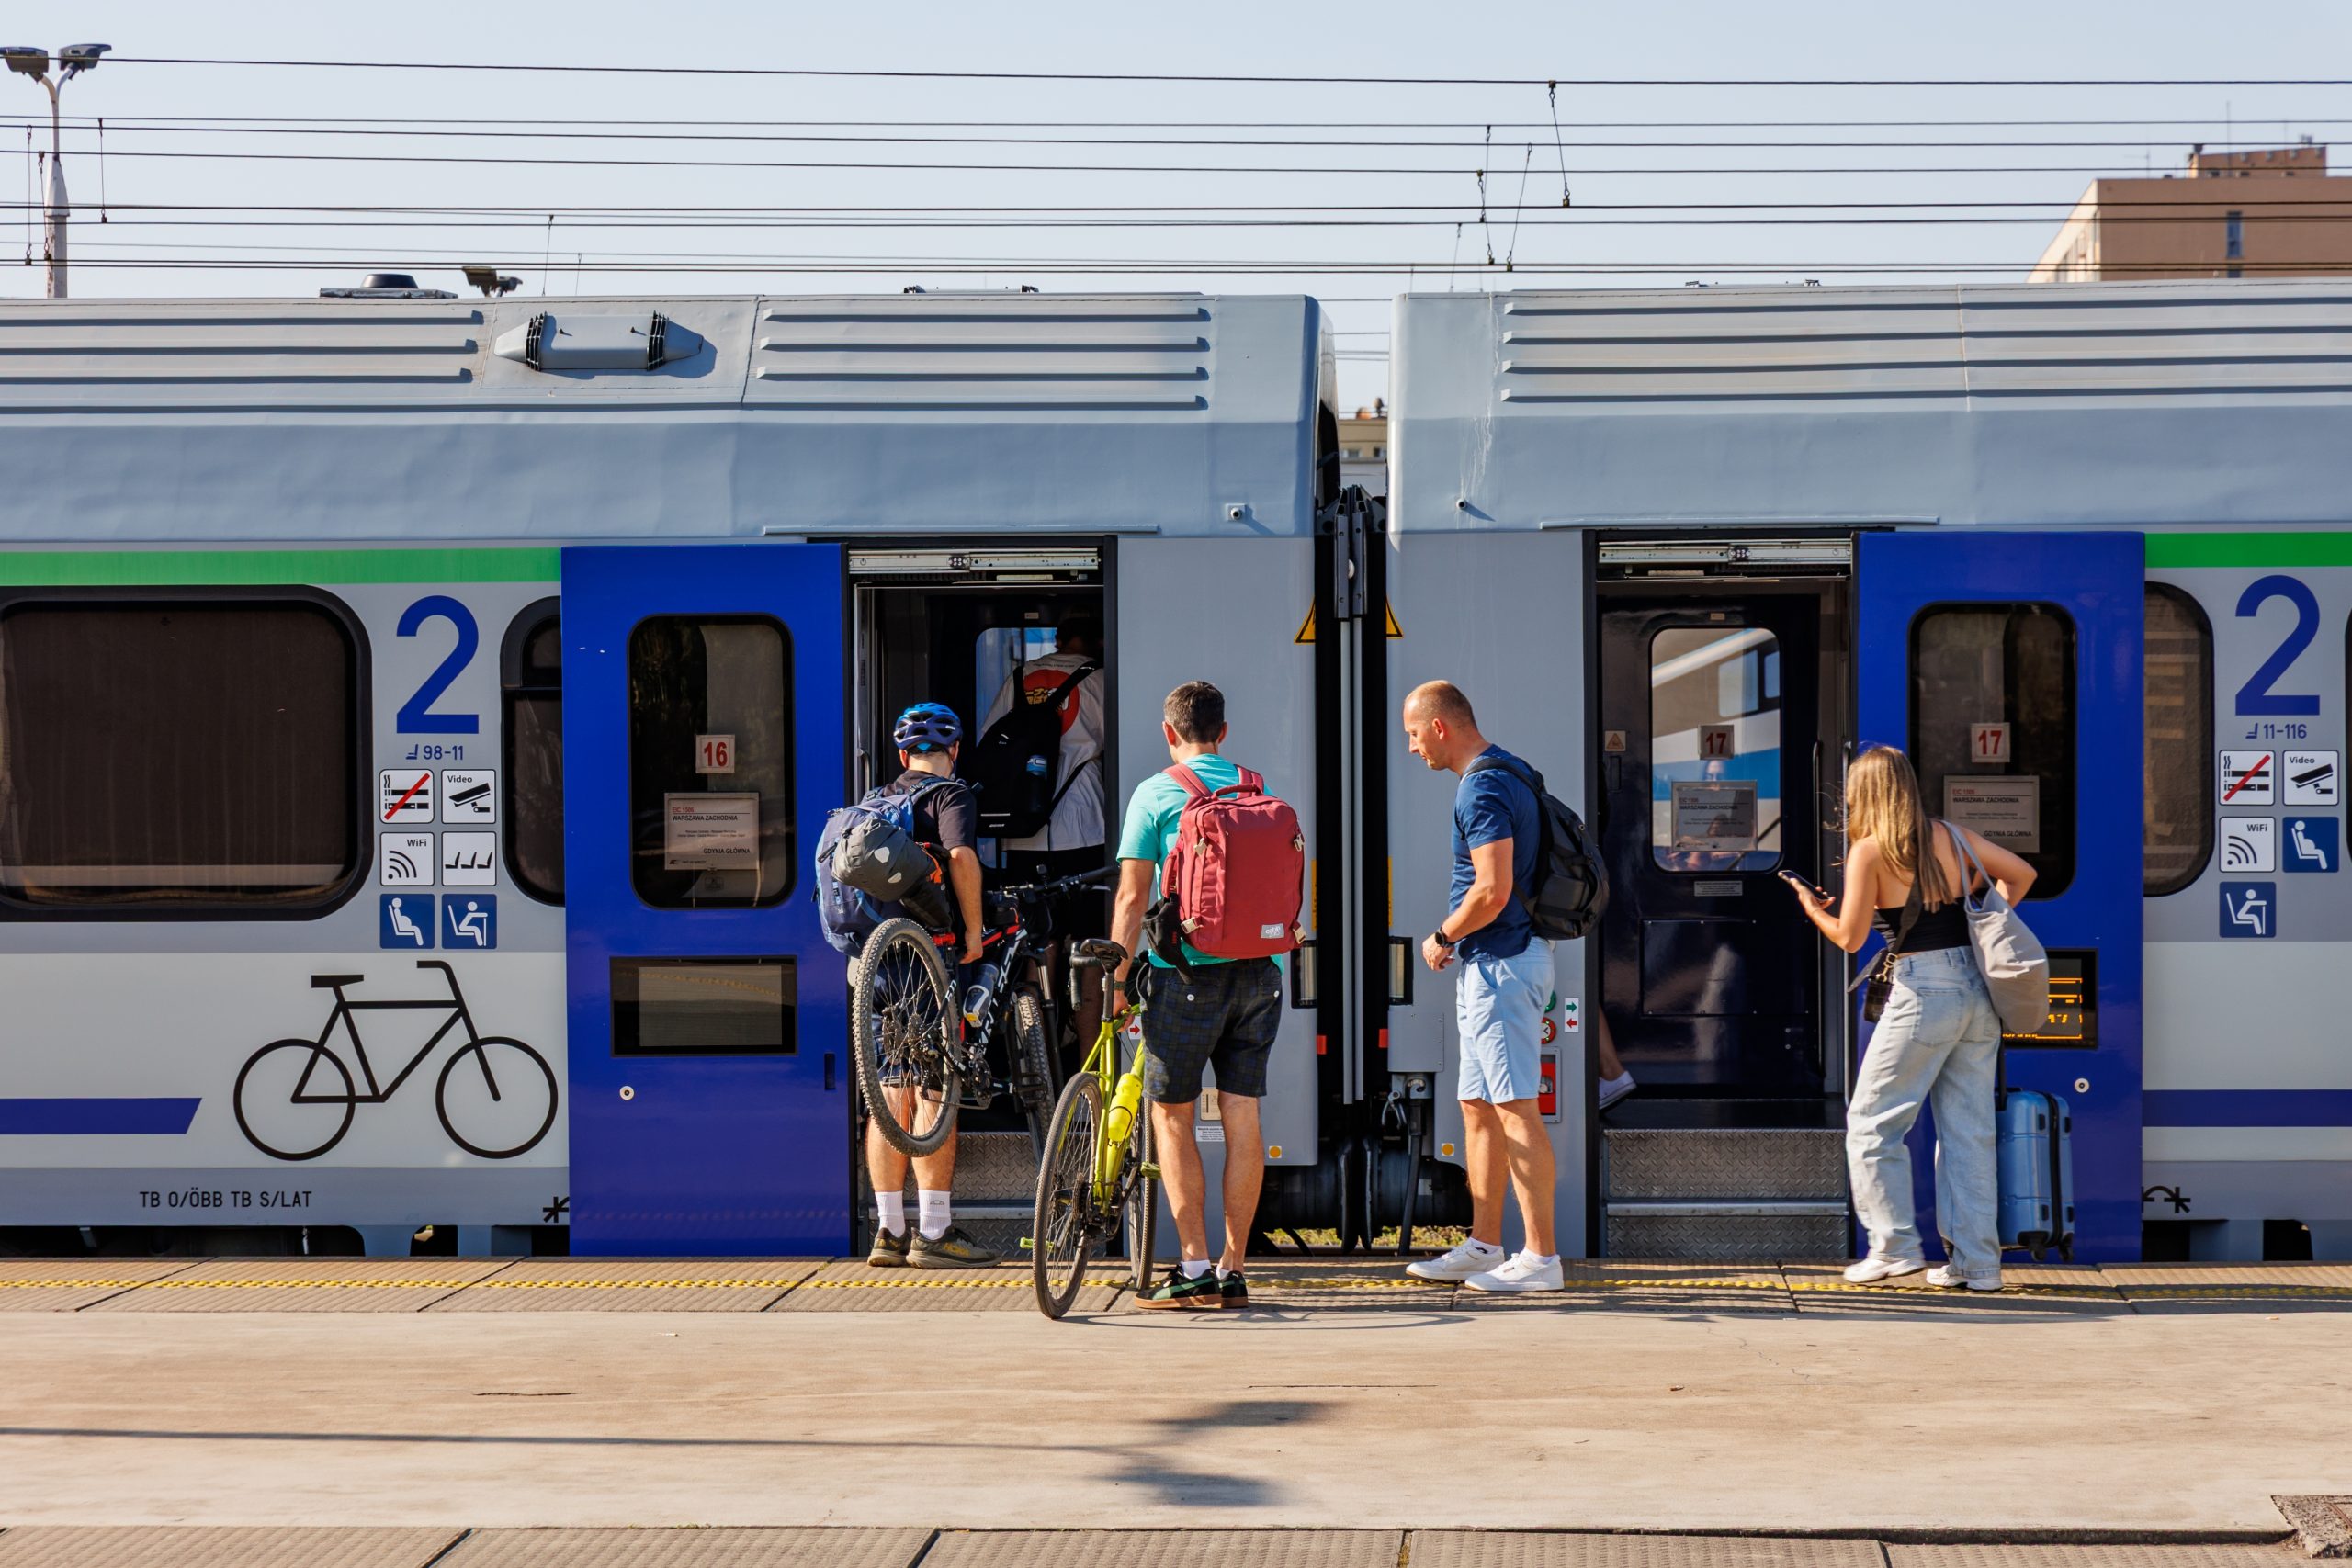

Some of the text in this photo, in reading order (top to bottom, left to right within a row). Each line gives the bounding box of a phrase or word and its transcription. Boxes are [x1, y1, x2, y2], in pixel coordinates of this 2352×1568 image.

[2235, 574, 2320, 716] 2
[396, 594, 480, 734] 2
[2263, 724, 2307, 739] 11-116
[1705, 732, 1726, 754] 17
[1977, 729, 2003, 755] 17
[423, 745, 464, 761] 98-11
[703, 741, 728, 768] 16
[2289, 756, 2315, 764] Video
[447, 775, 473, 784] Video
[2246, 823, 2268, 832] WiFi
[406, 838, 427, 847] WiFi
[140, 1191, 161, 1208] TB
[231, 1191, 252, 1208] TB
[259, 1191, 312, 1208] S/LAT
